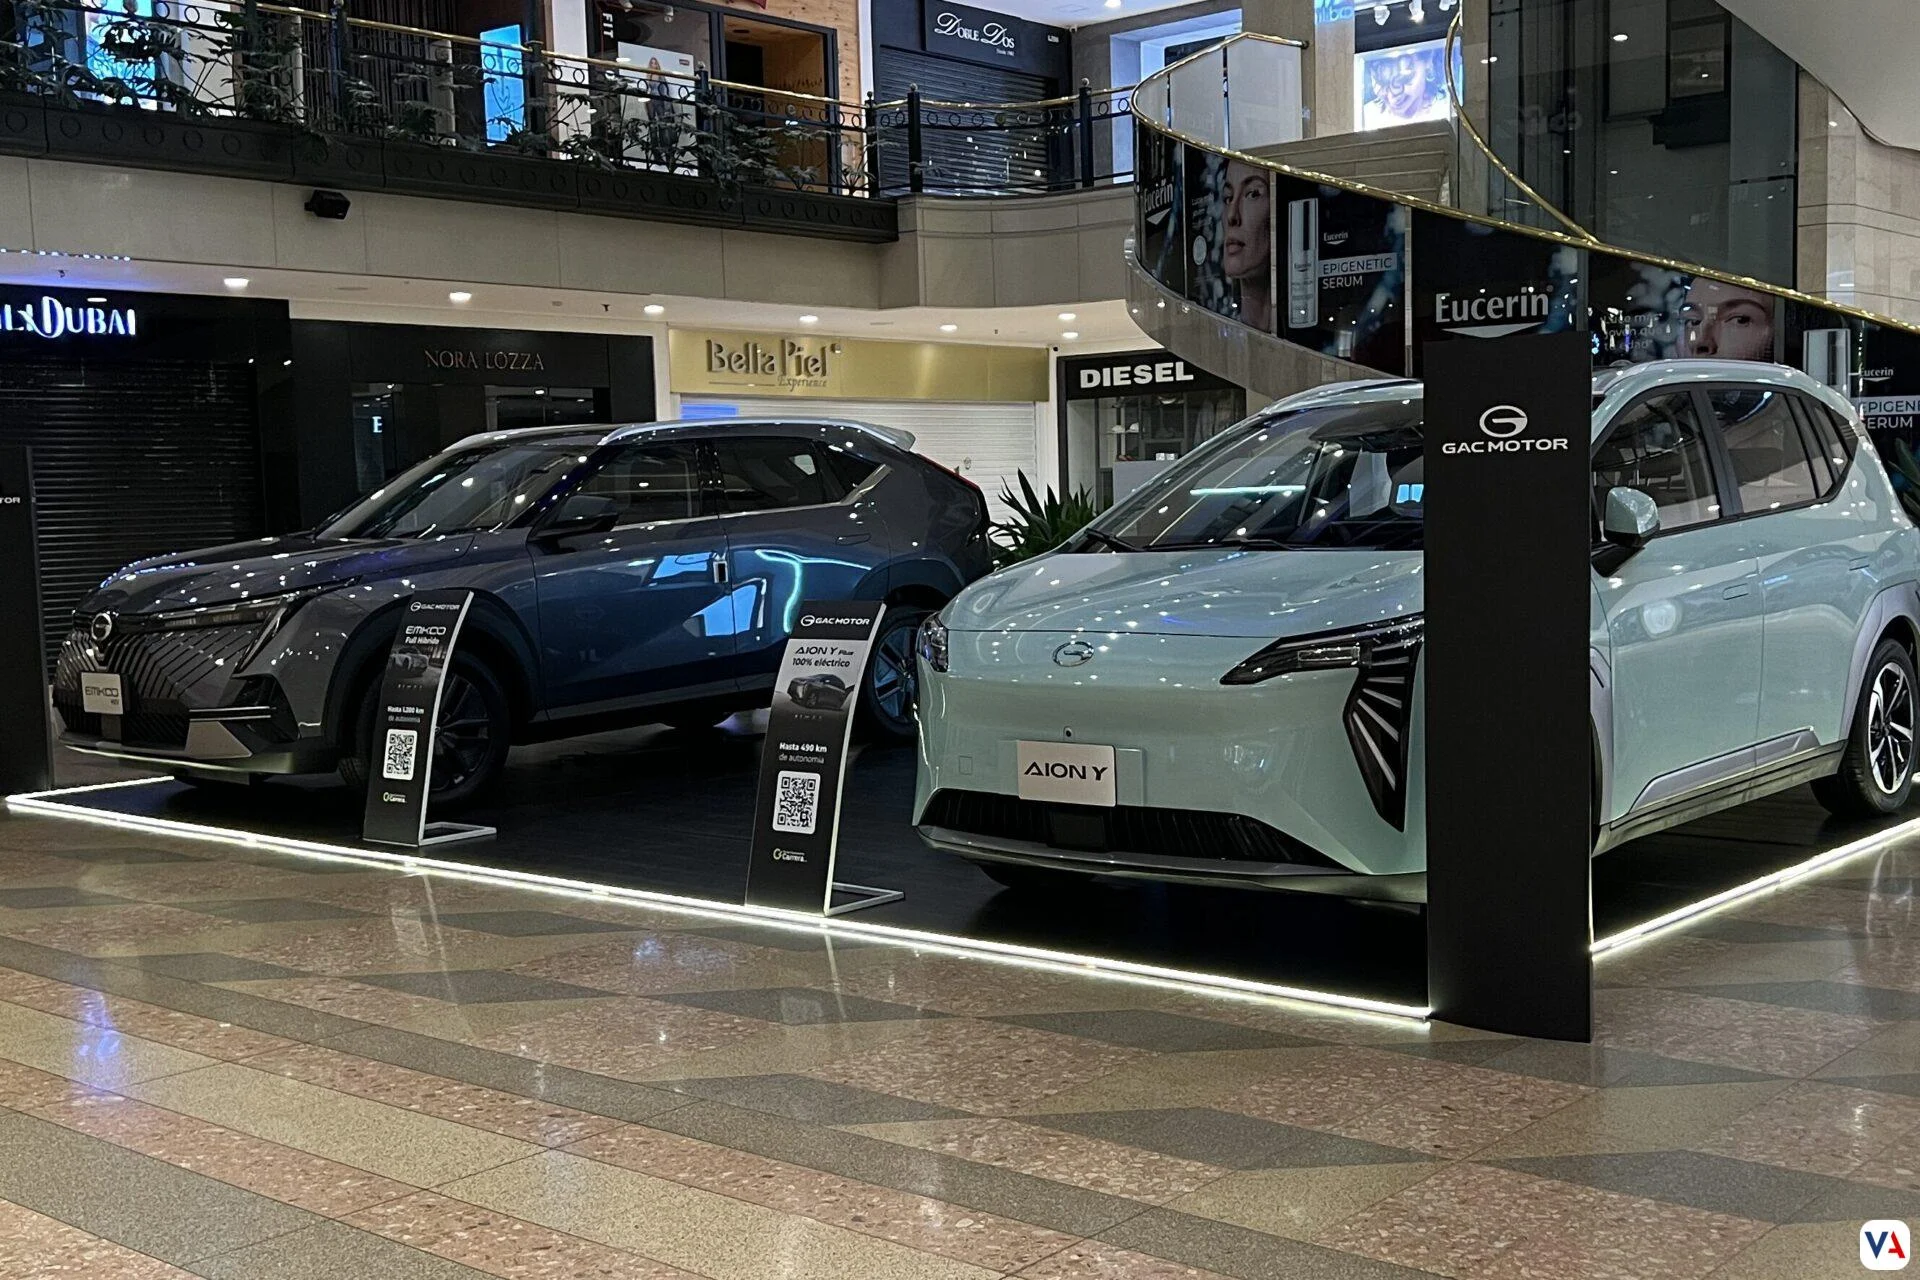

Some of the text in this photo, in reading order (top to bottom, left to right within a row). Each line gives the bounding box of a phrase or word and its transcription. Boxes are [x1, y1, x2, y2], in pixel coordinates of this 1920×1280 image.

[602, 12, 614, 38] FIT
[980, 22, 1015, 48] DOS
[1323, 231, 1349, 242] Eucerin
[1322, 257, 1392, 275] EPIGENETIC
[1322, 275, 1363, 289] SERUM
[1435, 286, 1549, 323] Eucerin
[424, 350, 544, 370] NORA LOZZA
[706, 338, 828, 377] Bella Piel
[1080, 361, 1194, 389] DIESEL
[778, 376, 828, 392] Experience
[1442, 438, 1568, 454] GAC MOTOR
[815, 617, 835, 625] GAC
[795, 646, 828, 655] AION
[829, 647, 838, 655] Y
[792, 658, 851, 668] 100% eléctrico
[779, 742, 828, 753] Hasta 490 km
[779, 753, 788, 761] de
[1024, 761, 1108, 781] AION Y
